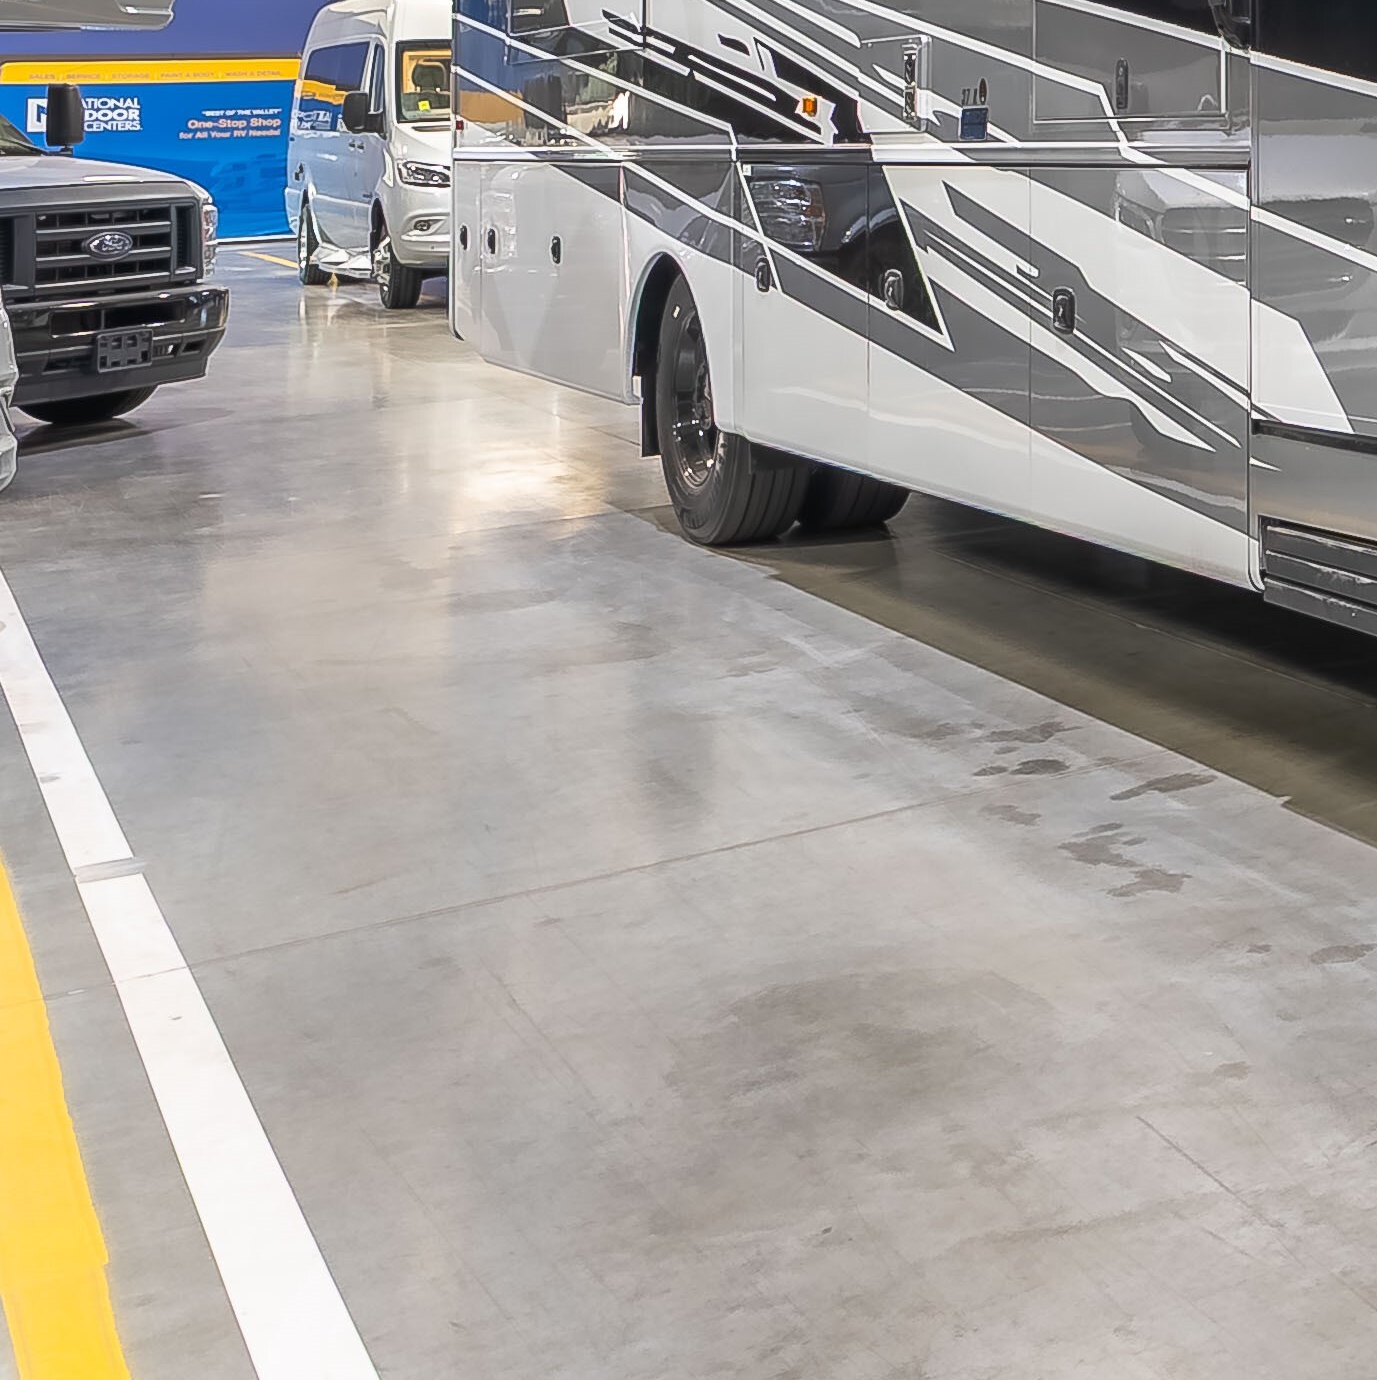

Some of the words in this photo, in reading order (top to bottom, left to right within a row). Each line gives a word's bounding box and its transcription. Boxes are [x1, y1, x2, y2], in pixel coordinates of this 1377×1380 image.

[81, 97, 141, 109] TIONAL
[84, 109, 140, 121] DOOR
[188, 119, 247, 130] One-Stop
[249, 117, 281, 128] Shop
[179, 131, 194, 140] for
[210, 130, 231, 139] Your
[233, 129, 247, 138] RV
